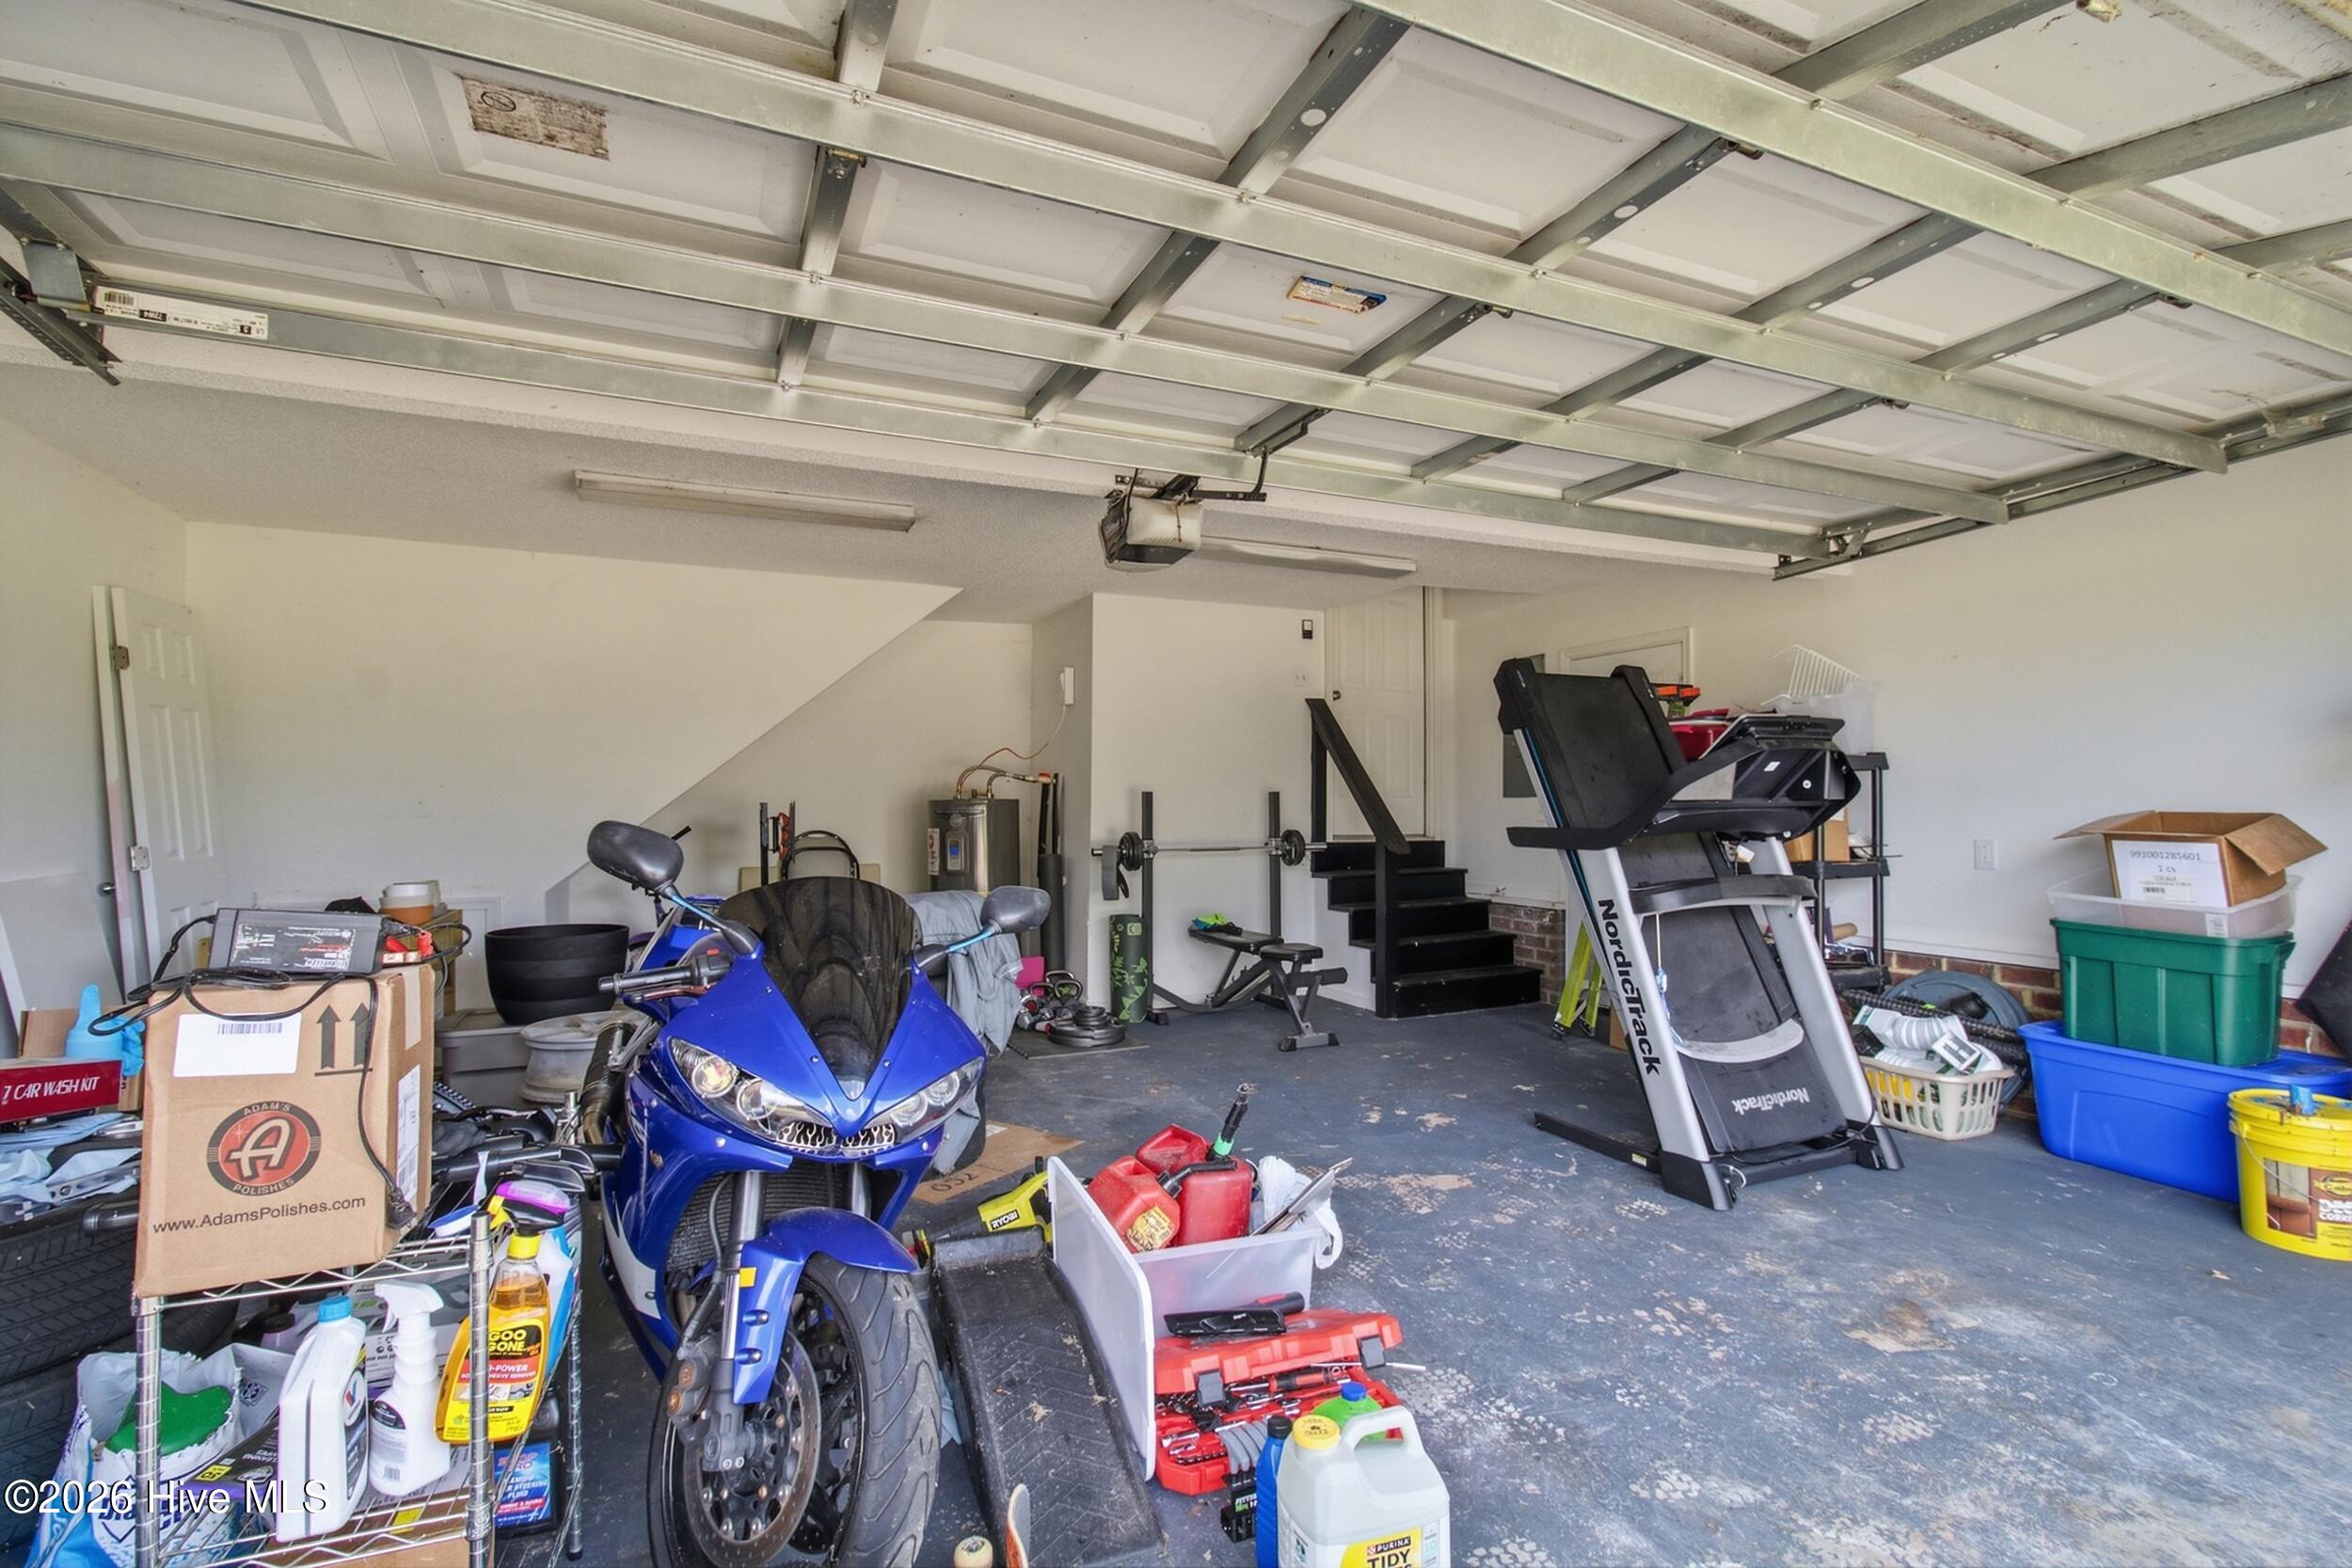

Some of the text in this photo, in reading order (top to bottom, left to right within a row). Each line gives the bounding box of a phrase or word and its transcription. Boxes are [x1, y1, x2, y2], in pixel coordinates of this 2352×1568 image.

[1598, 899, 1661, 1076] NordicTrack
[13, 1083, 40, 1100] CAR
[42, 1079, 78, 1097] WASH
[80, 1076, 101, 1091] KIT
[1731, 1087, 1810, 1116] NordicTrack
[232, 1178, 295, 1195] POLISHES
[153, 1196, 366, 1233] www.AdamsPolishes.com
[991, 1211, 1018, 1228] RYOBI
[489, 1329, 527, 1341] GOO
[1377, 1537, 1410, 1552] PURINA
[1367, 1548, 1410, 1568] TIDY
